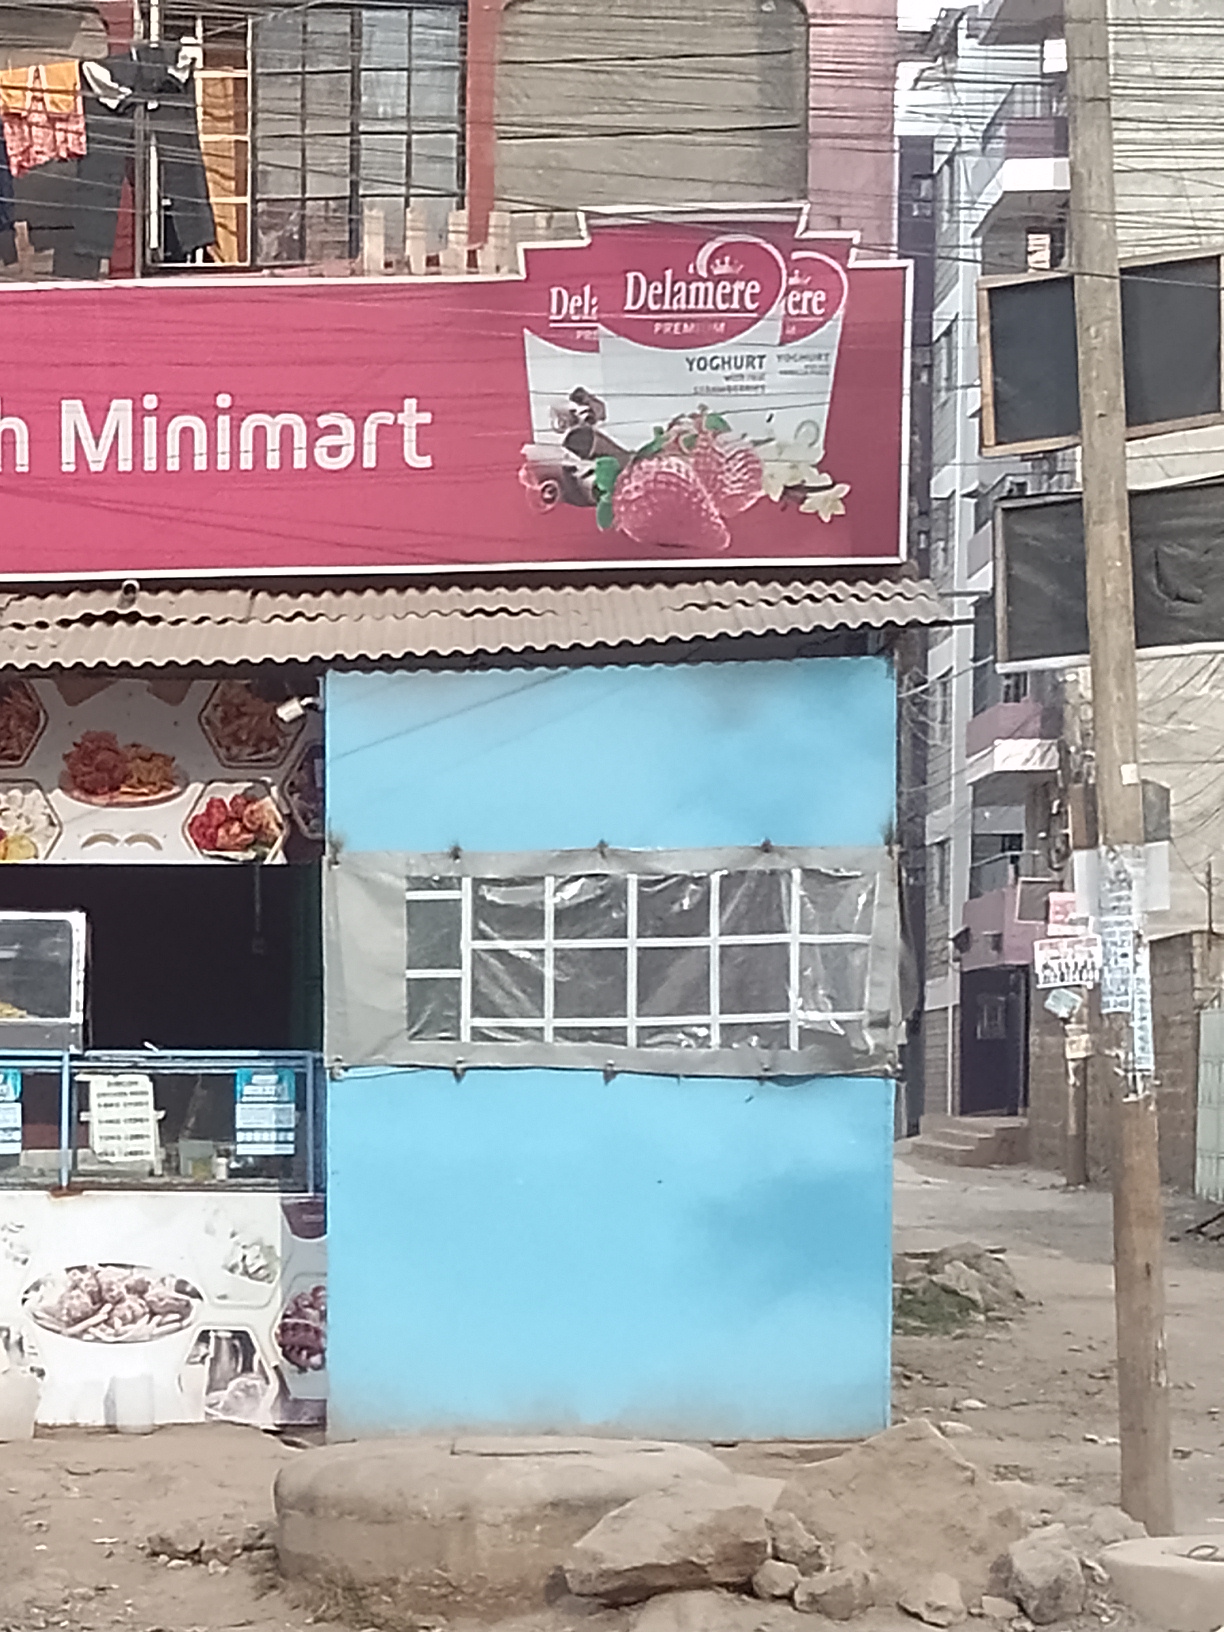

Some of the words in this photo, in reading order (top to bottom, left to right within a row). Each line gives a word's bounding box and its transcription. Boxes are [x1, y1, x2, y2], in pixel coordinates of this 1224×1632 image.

[623, 268, 761, 311] Delamere
[685, 354, 767, 372] YOGHURT
[60, 393, 433, 473] Minimart
